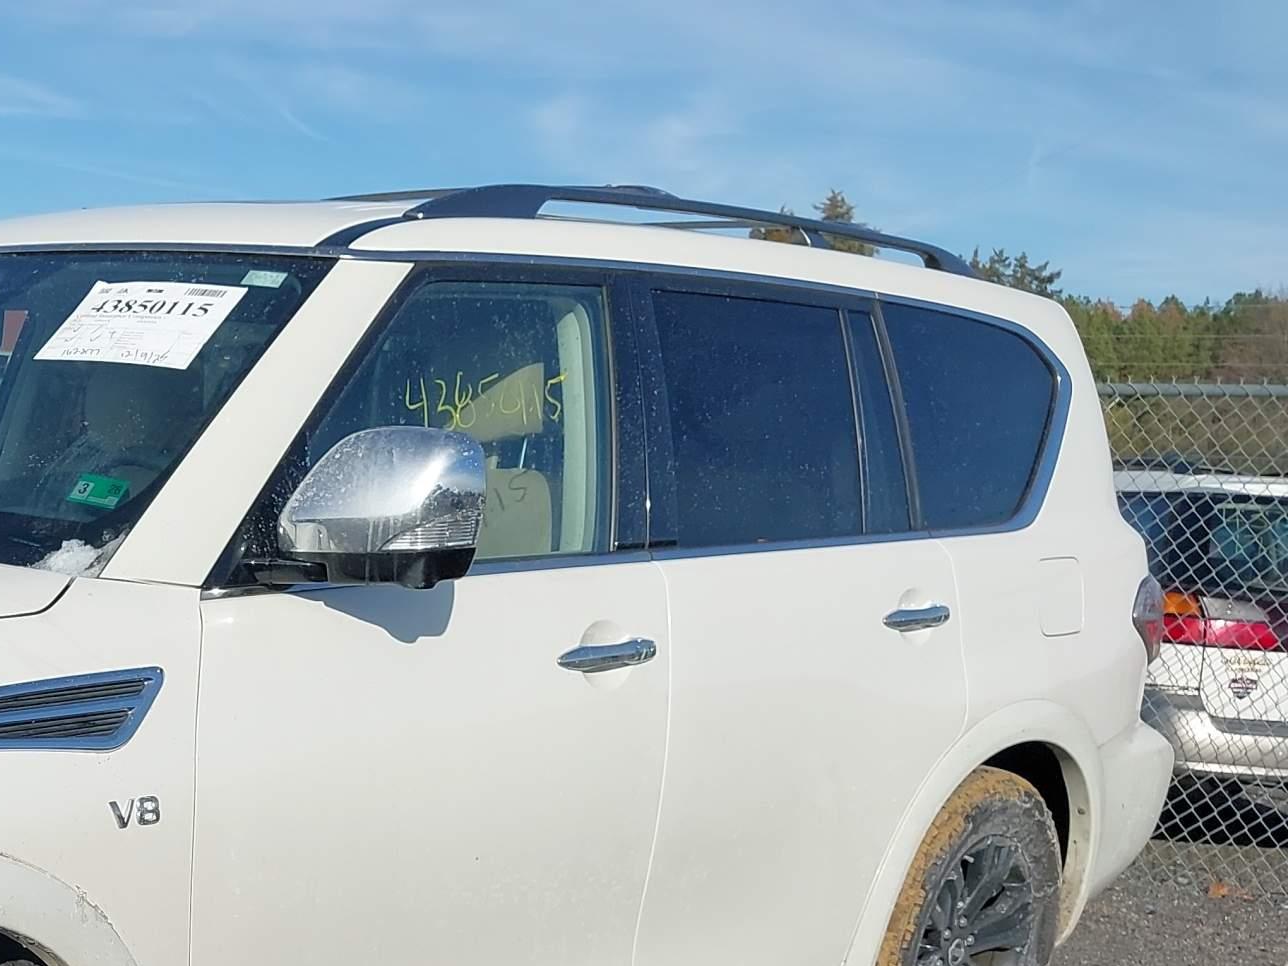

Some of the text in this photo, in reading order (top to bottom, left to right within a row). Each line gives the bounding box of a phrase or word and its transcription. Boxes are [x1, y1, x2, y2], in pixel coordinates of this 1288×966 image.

[91, 299, 213, 317] 43850115
[78, 482, 90, 494] 3
[108, 796, 161, 829] V8
